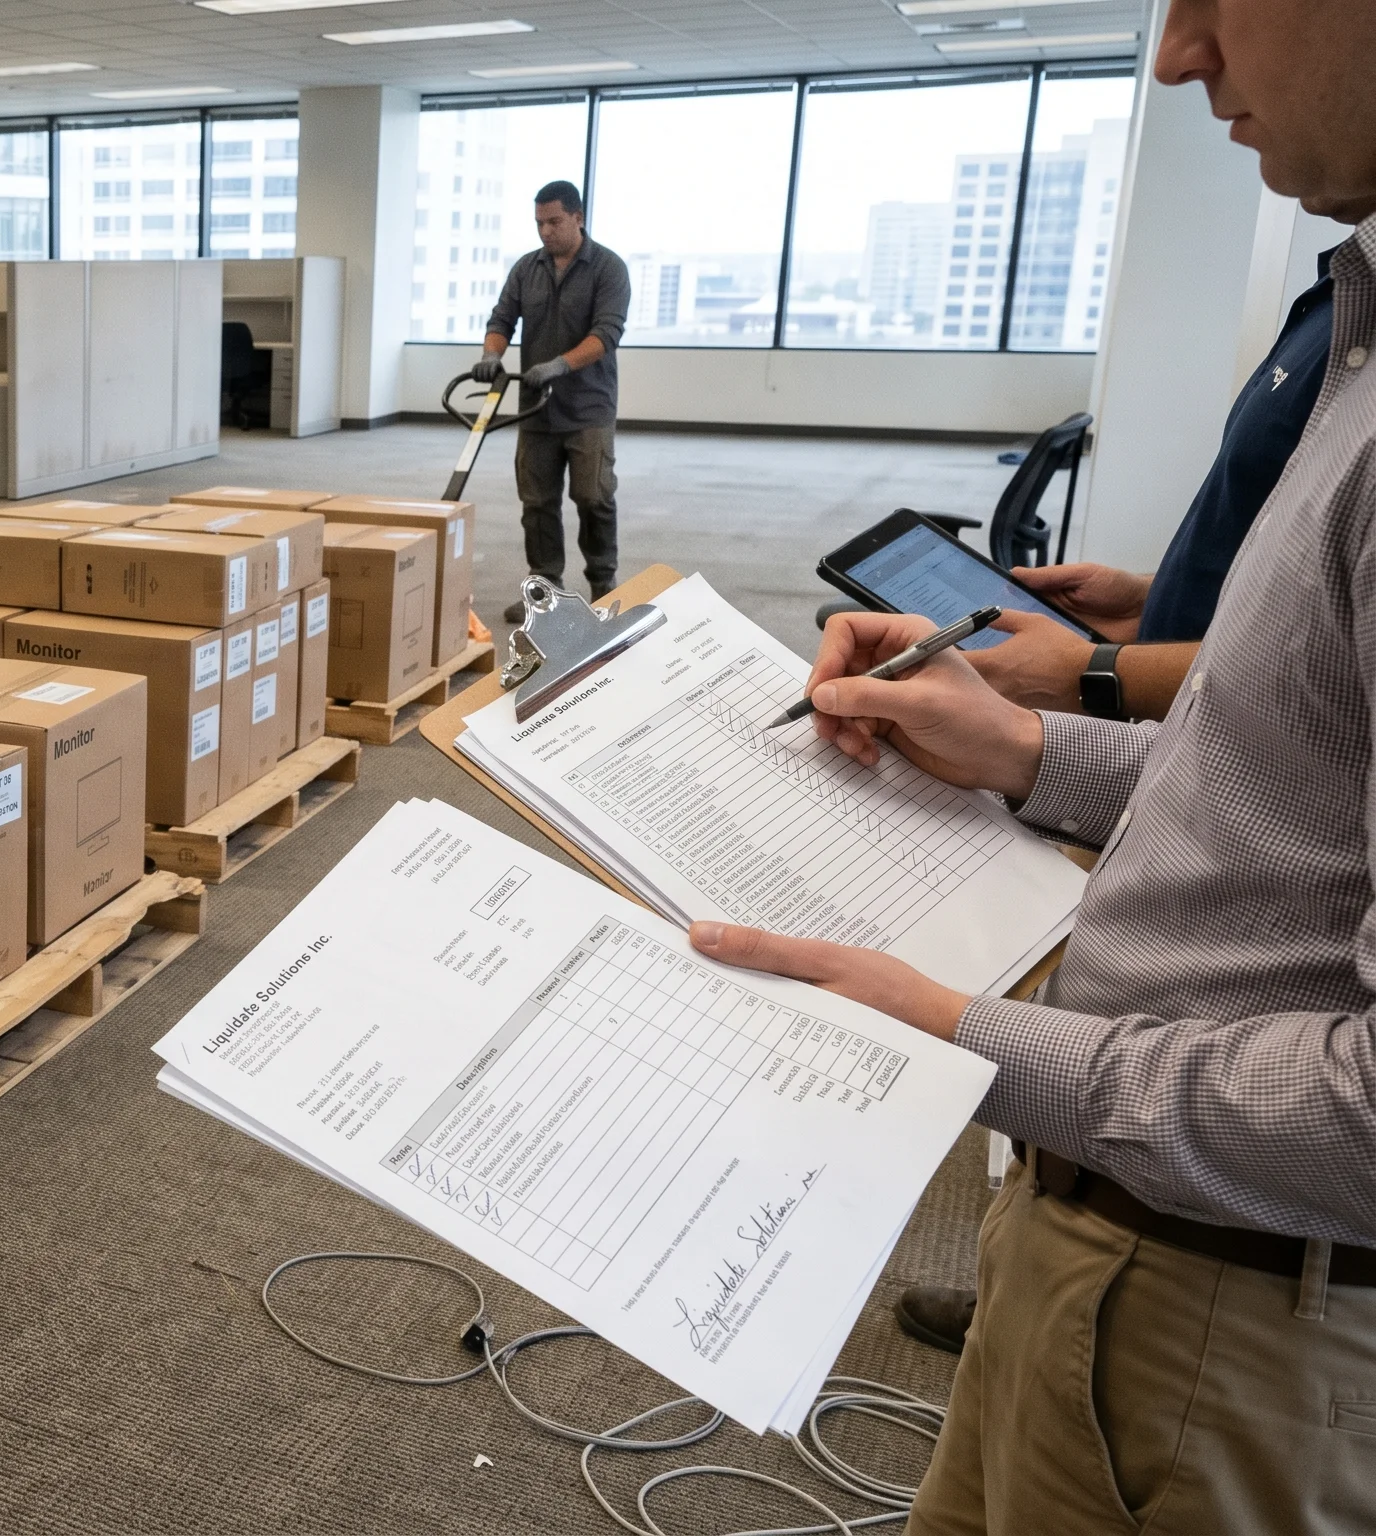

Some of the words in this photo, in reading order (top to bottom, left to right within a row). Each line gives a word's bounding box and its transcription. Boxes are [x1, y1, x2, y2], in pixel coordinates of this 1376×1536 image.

[16, 638, 82, 660] Monitor
[54, 728, 95, 760] Monitor
[308, 935, 333, 953] Inc.
